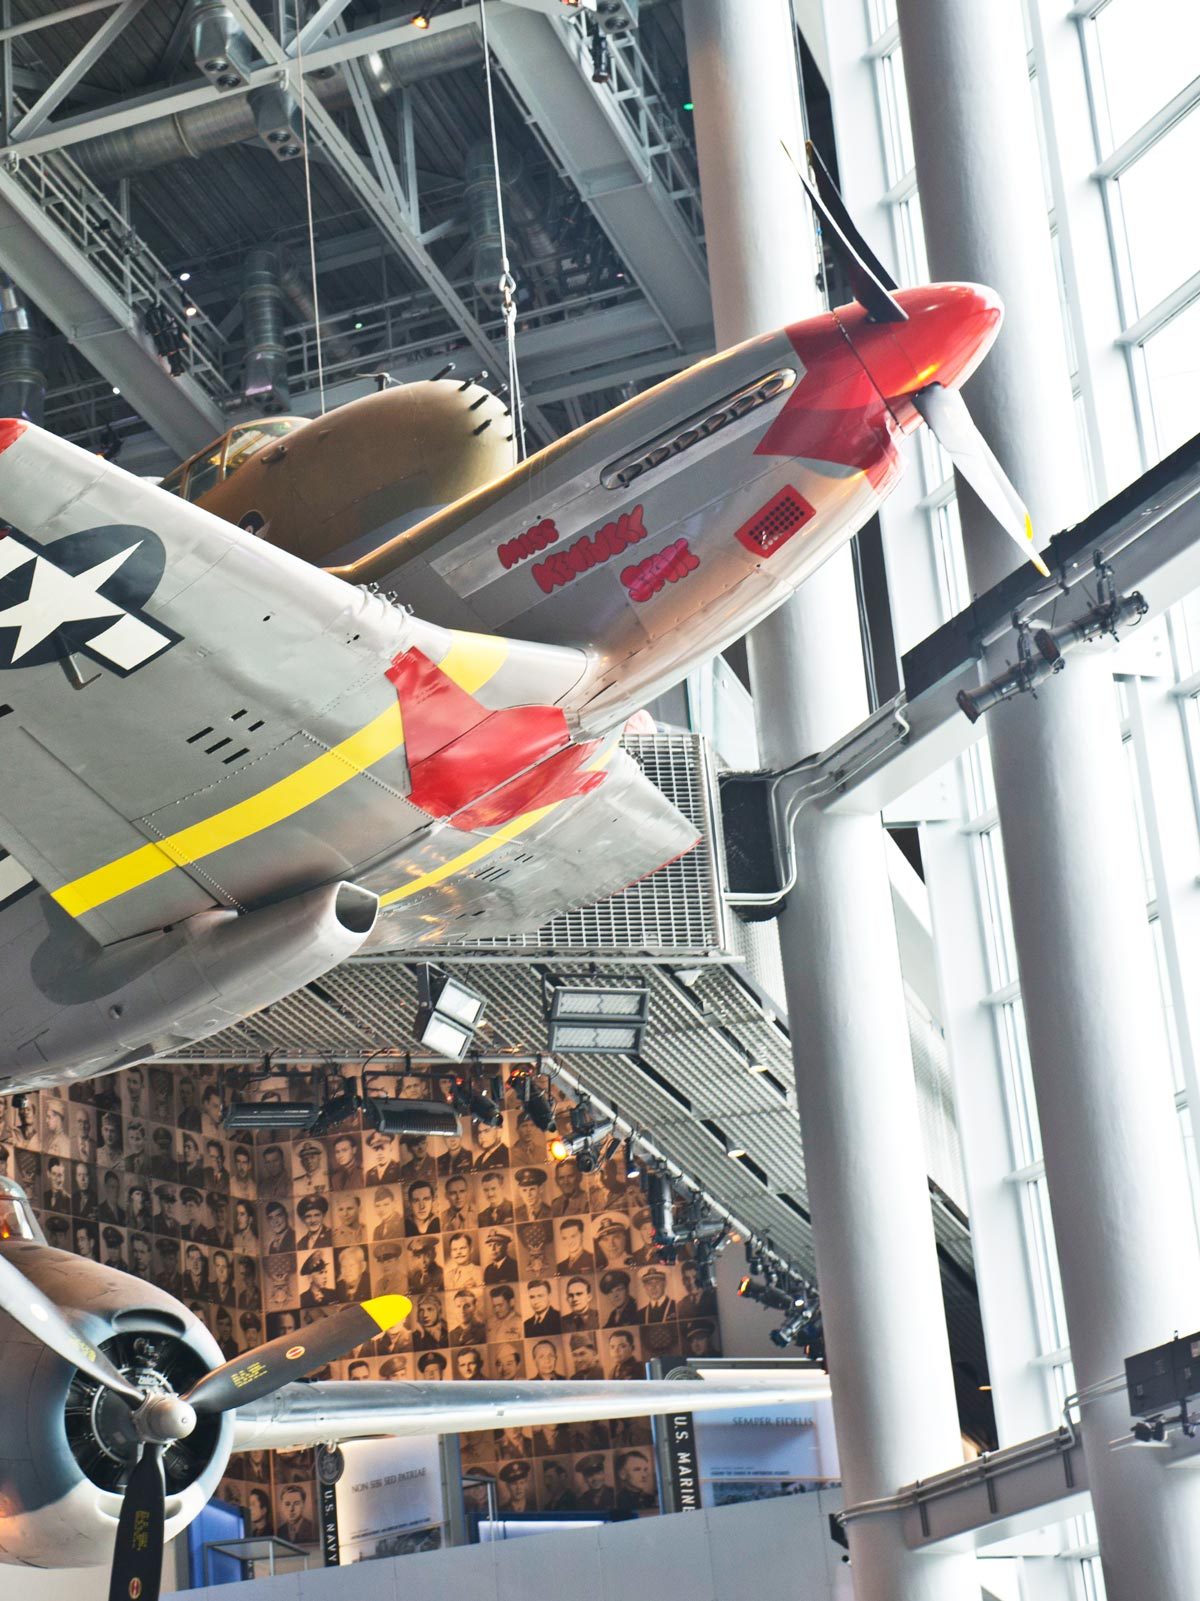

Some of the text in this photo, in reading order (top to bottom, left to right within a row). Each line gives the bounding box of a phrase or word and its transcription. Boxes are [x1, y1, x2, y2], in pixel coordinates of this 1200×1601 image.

[497, 519, 559, 569] MISS
[531, 504, 648, 594] KENTUCKY
[673, 1416, 689, 1444] U.S.
[326, 1523, 337, 1561] NAVY
